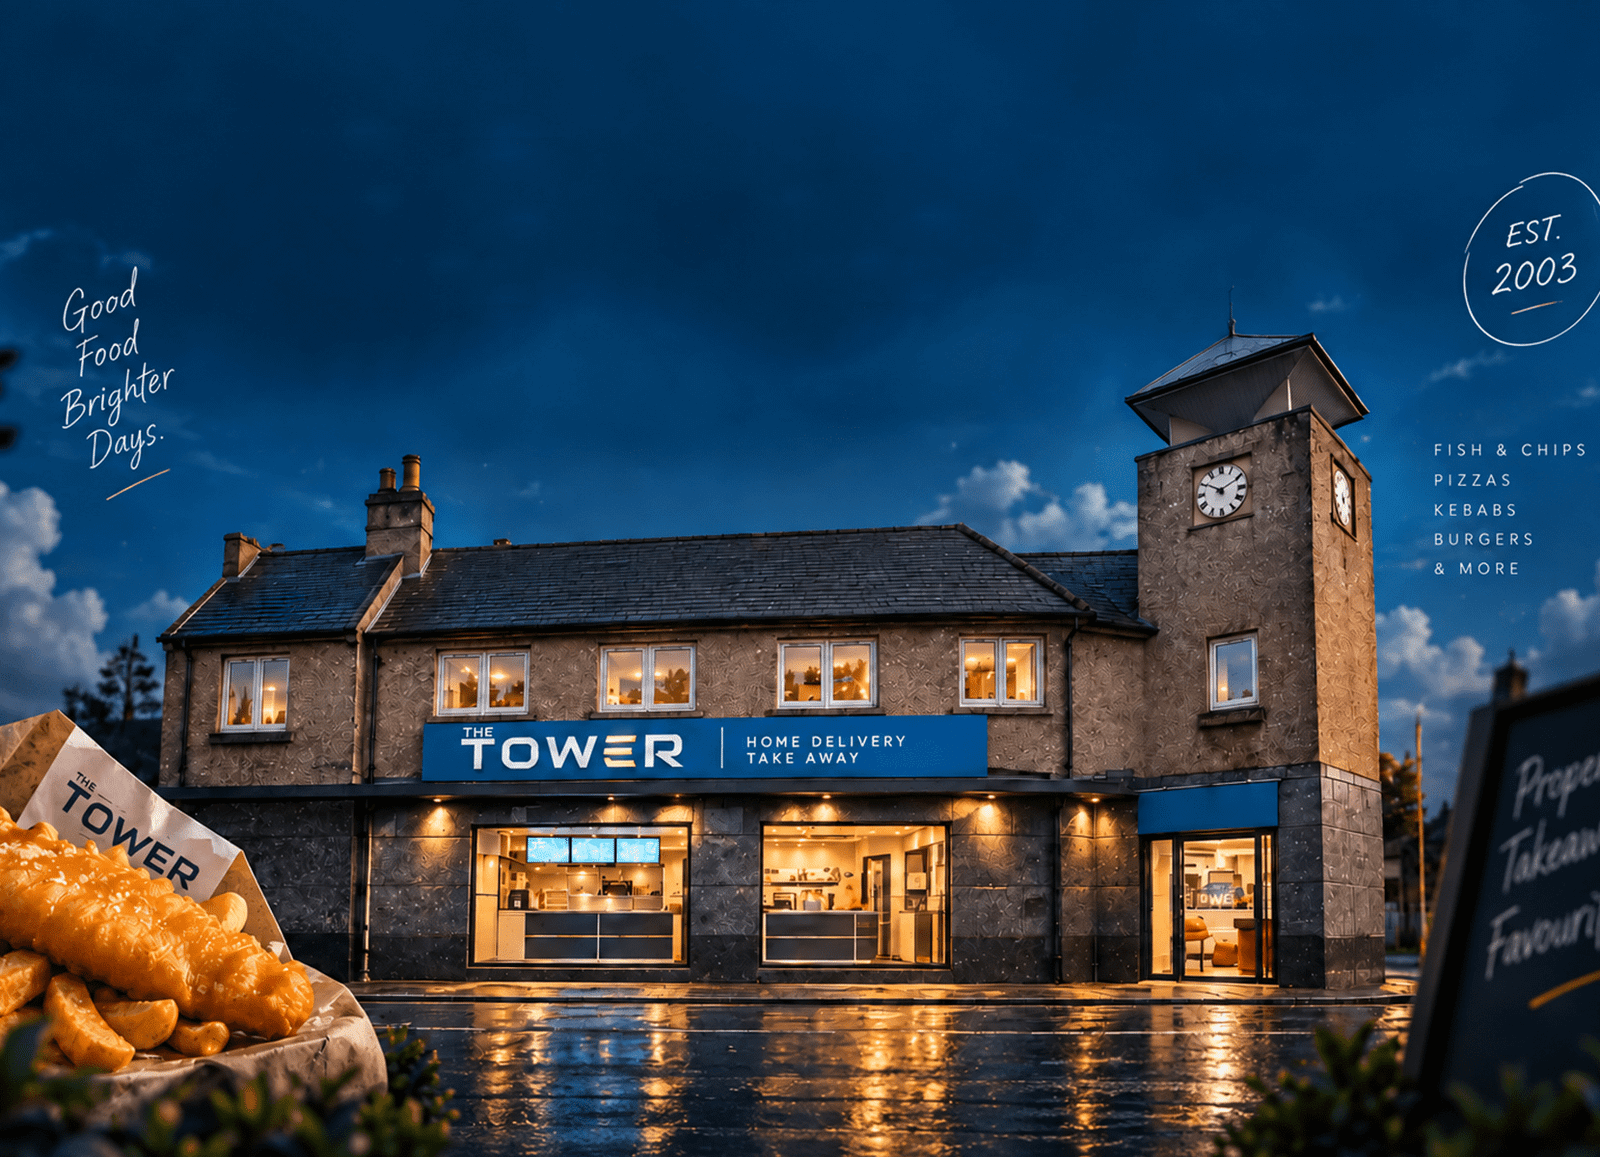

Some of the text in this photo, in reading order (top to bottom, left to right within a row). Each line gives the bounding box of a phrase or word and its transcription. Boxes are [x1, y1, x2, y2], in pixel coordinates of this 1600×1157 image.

[462, 726, 494, 738] THE
[746, 735, 906, 748] HOME DELIVERY
[460, 733, 684, 770] TOWER
[746, 752, 859, 764] TAKE AWAY
[76, 771, 97, 793] THE
[62, 779, 200, 891] TOWER
